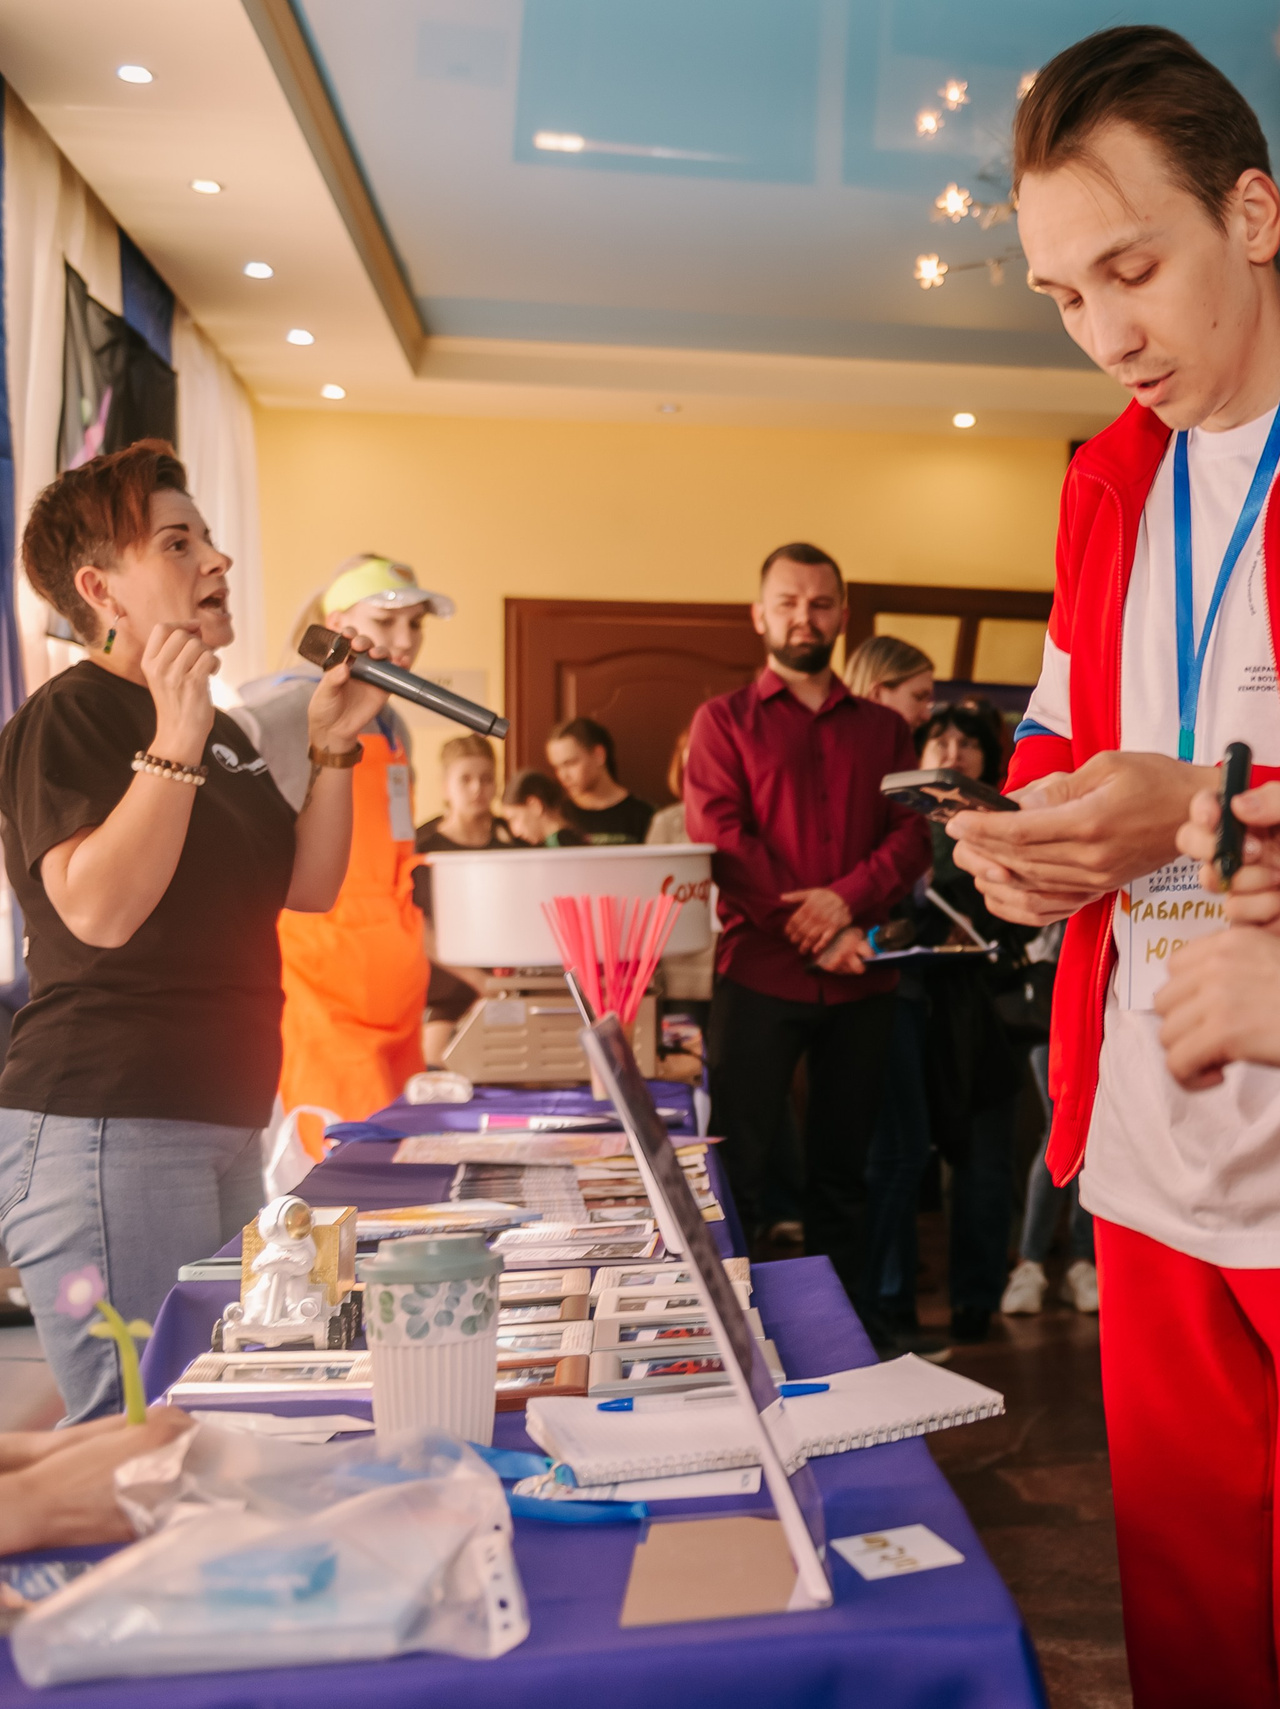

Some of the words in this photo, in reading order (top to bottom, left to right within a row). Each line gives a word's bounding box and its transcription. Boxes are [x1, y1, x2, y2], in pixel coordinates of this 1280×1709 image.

[1156, 863, 1204, 875] АЗВИТ
[1149, 883, 1202, 893] ОБРАЗОВАН
[1145, 936, 1188, 963] ЮР
